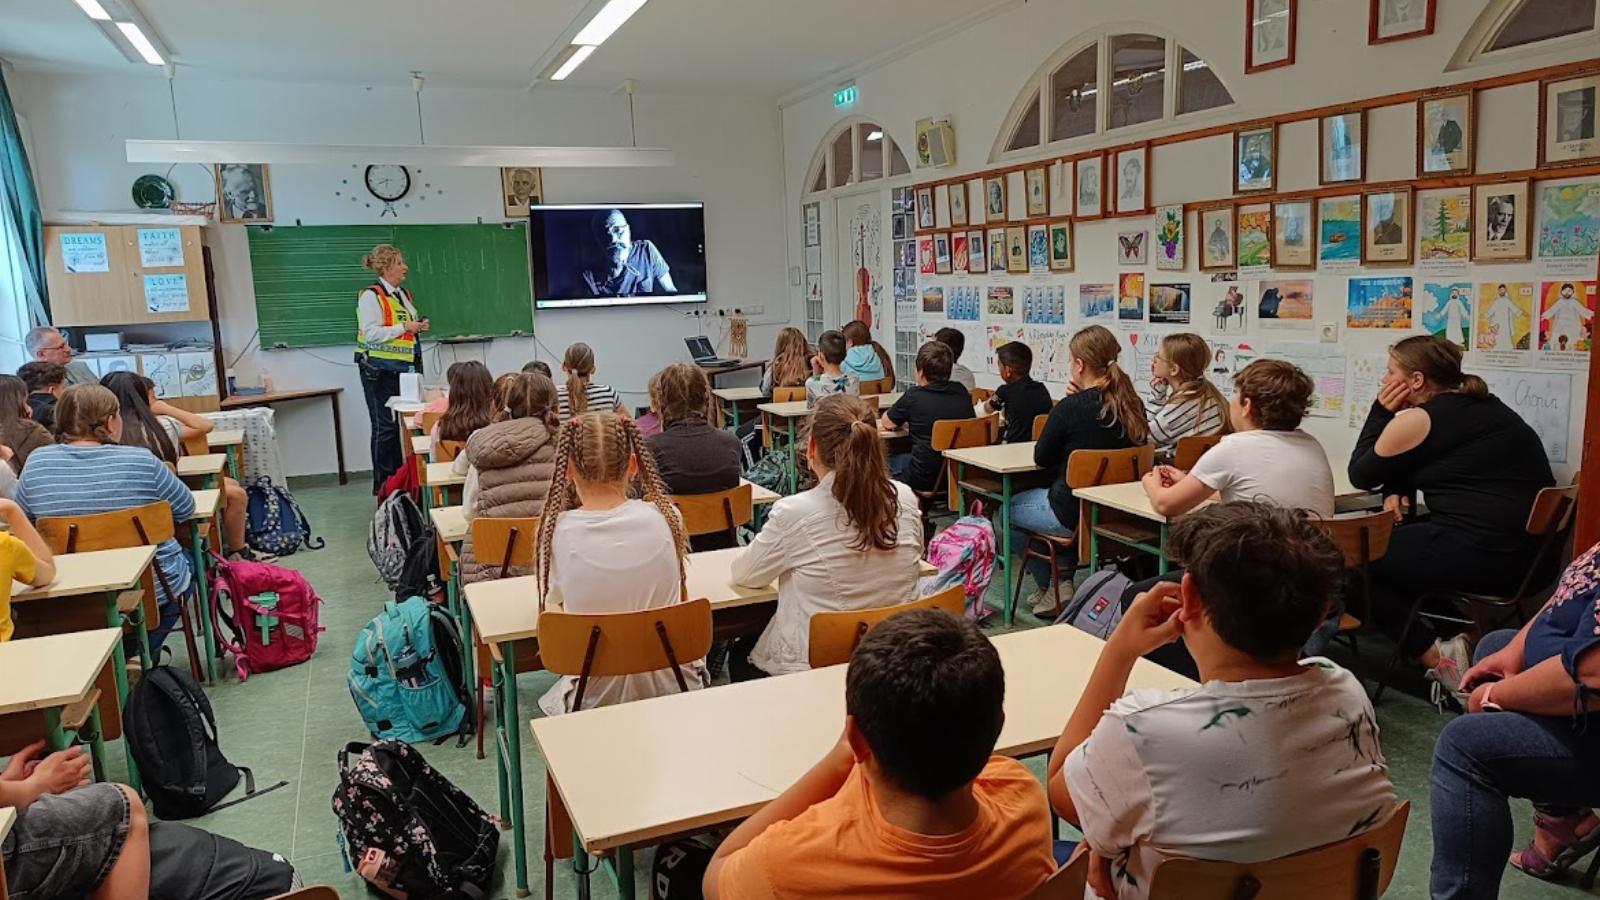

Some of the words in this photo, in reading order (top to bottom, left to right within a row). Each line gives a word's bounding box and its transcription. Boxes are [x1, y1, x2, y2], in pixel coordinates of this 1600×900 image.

[144, 231, 175, 240] FAITH
[64, 236, 103, 245] DREAMS
[152, 278, 178, 286] LOVE
